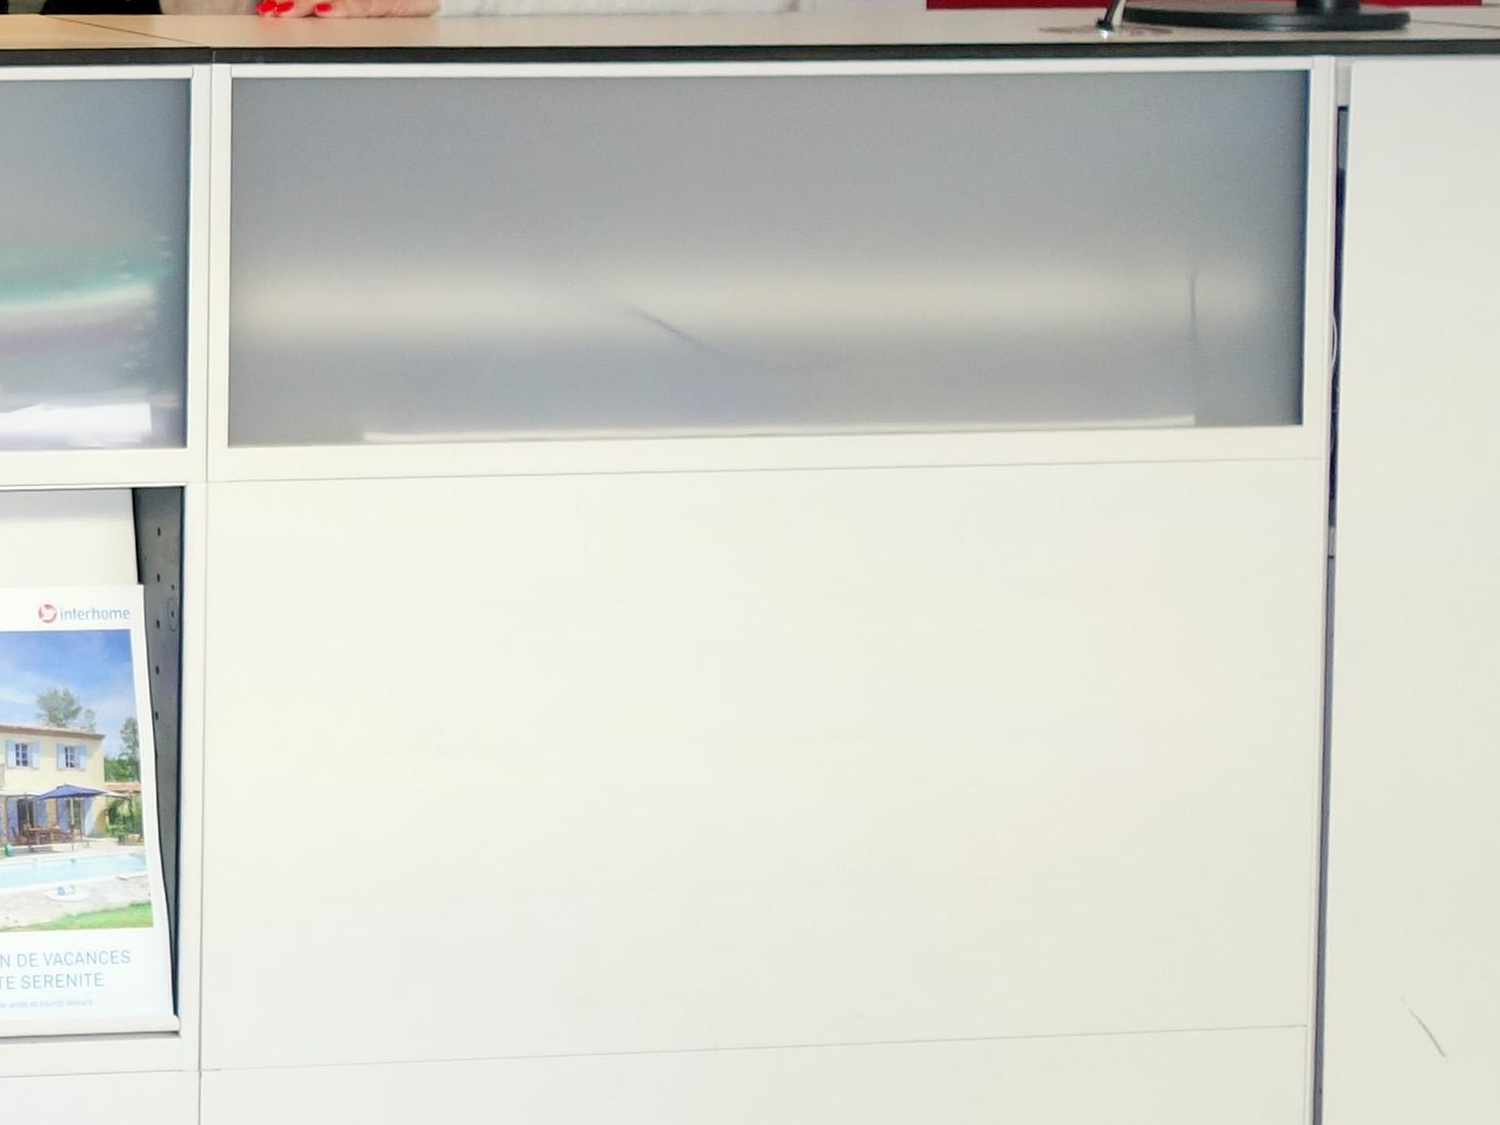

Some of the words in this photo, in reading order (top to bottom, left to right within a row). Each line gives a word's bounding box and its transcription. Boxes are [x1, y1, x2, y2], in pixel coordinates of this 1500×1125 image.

[59, 606, 131, 621] interhome
[17, 953, 38, 968] DE
[42, 949, 132, 967] VACANCES
[20, 972, 104, 989] SERENITE
